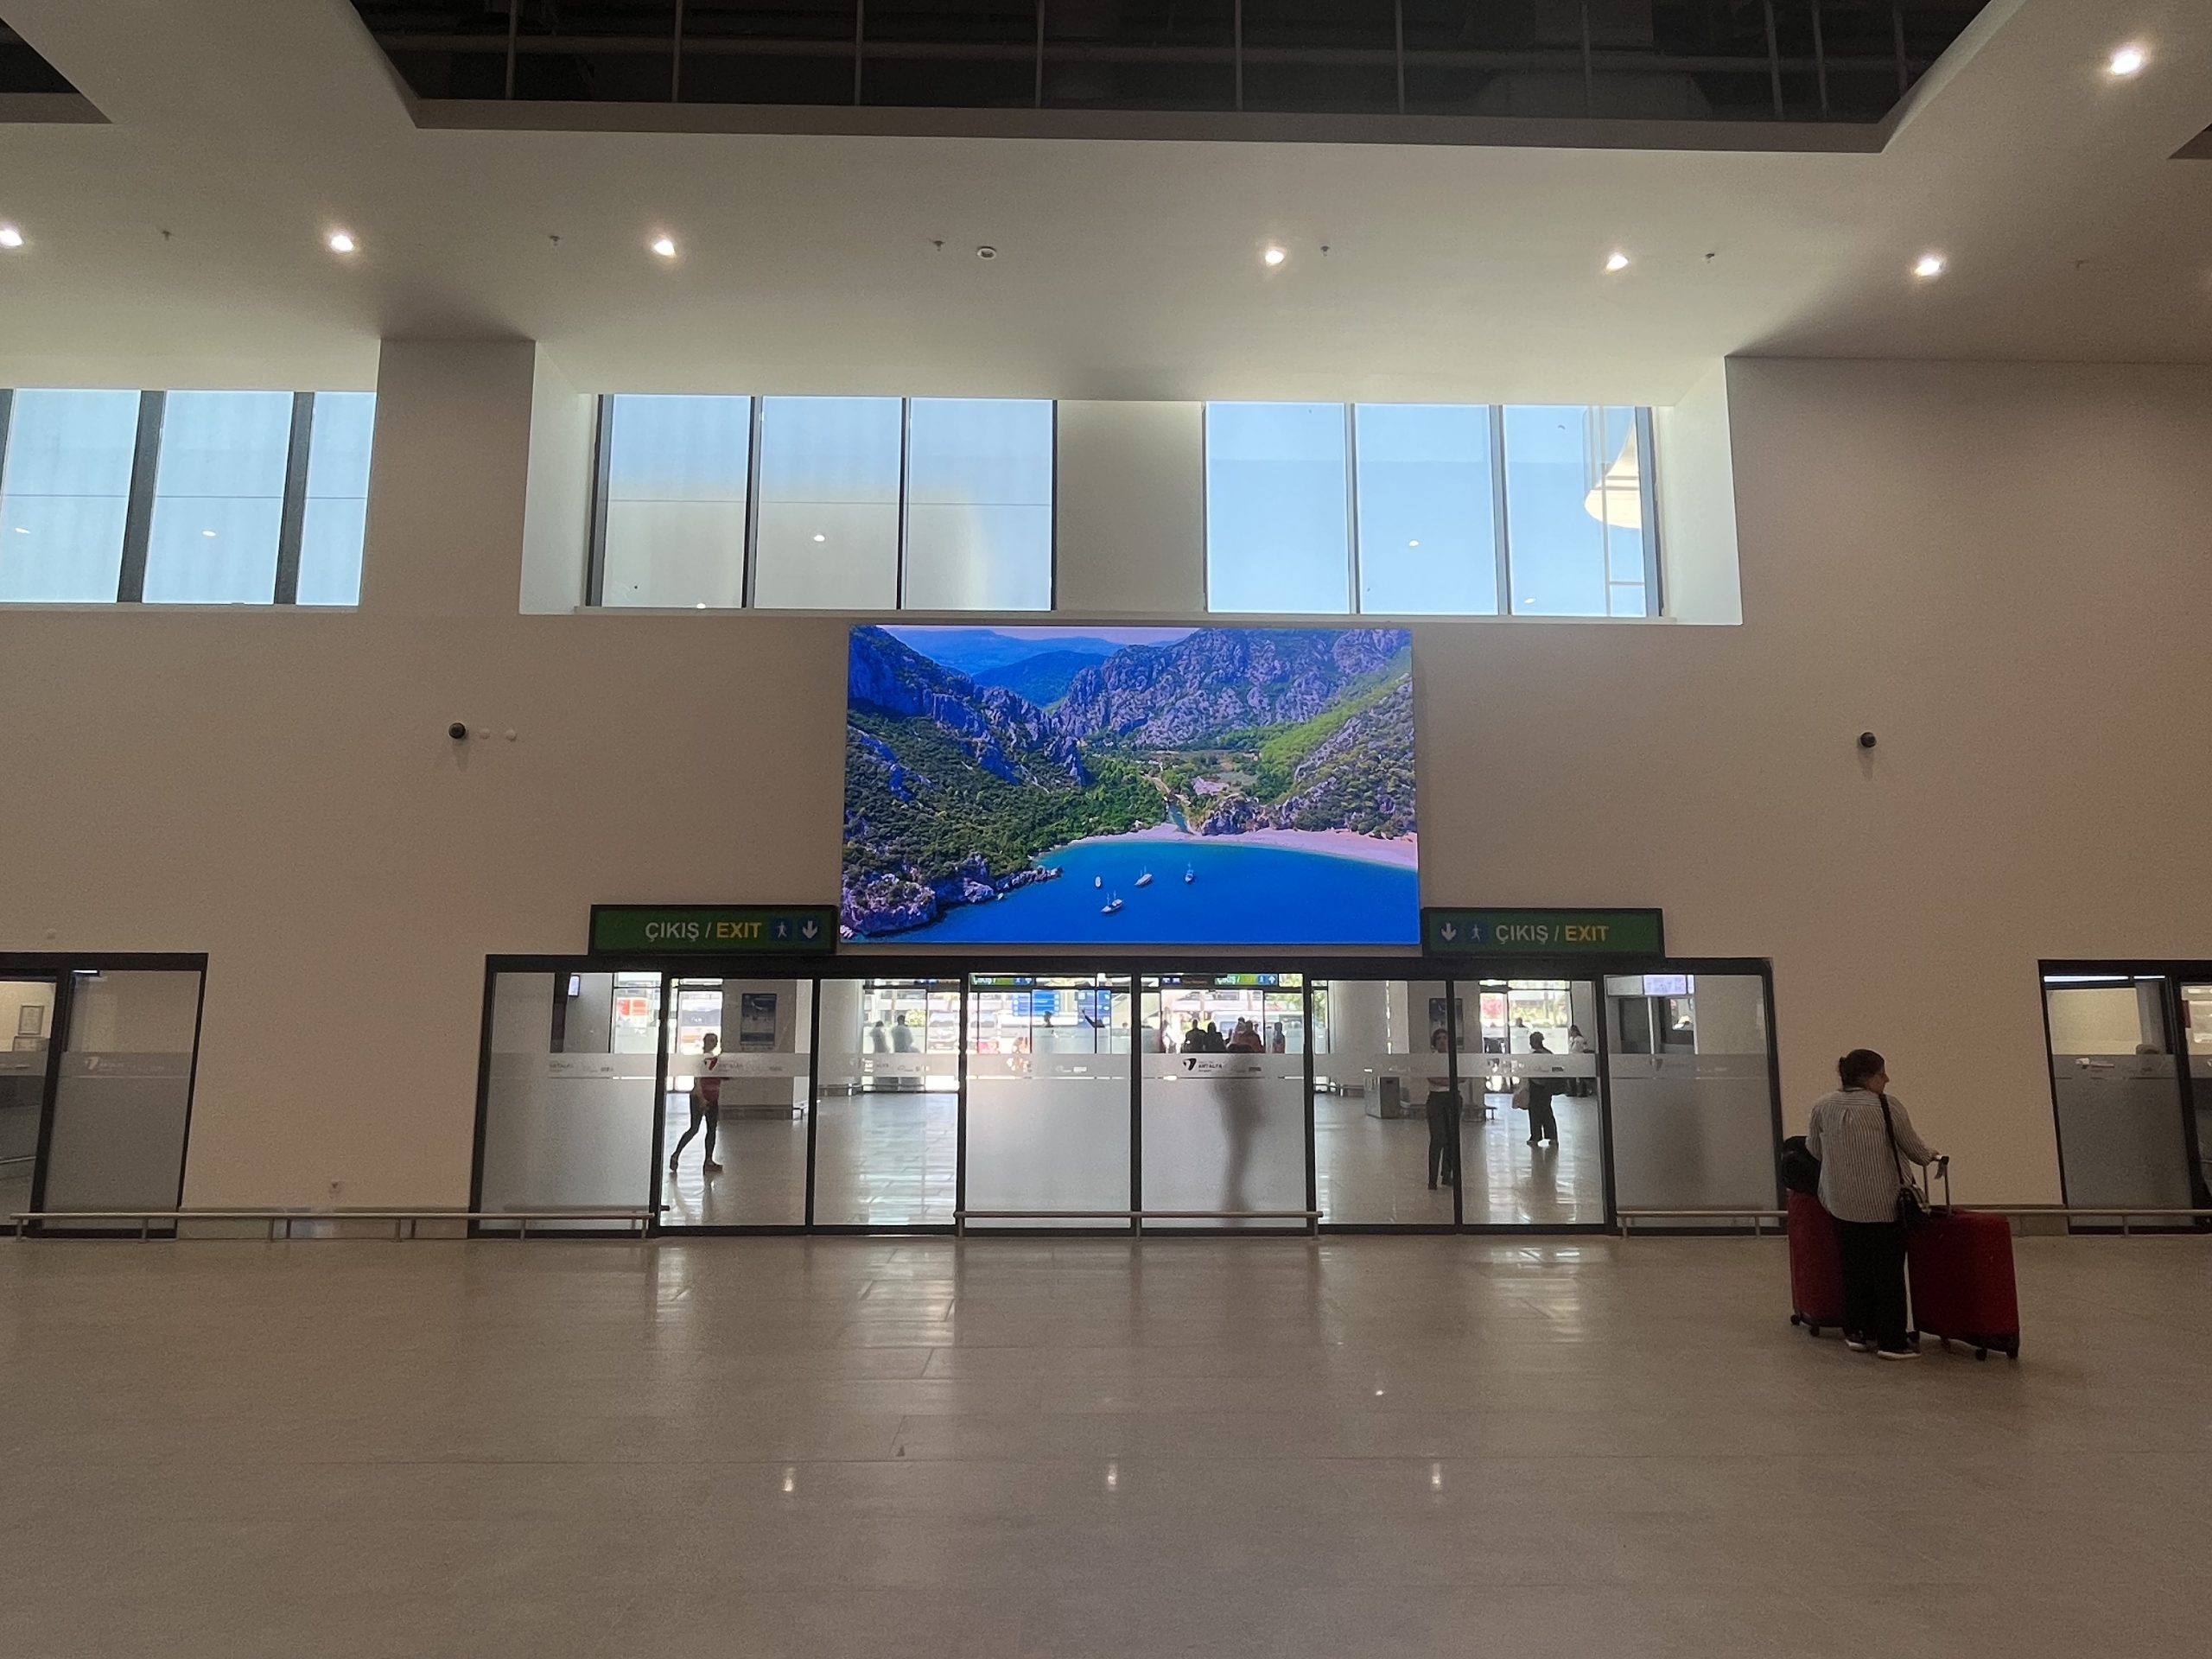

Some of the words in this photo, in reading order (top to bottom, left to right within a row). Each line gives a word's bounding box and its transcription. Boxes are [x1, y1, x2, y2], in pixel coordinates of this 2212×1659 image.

[645, 921, 699, 943] ÇIKIŞ
[716, 922, 761, 938] EXIT
[1496, 925, 1549, 944] ÇIKIŞ
[1566, 925, 1609, 941] EXIT
